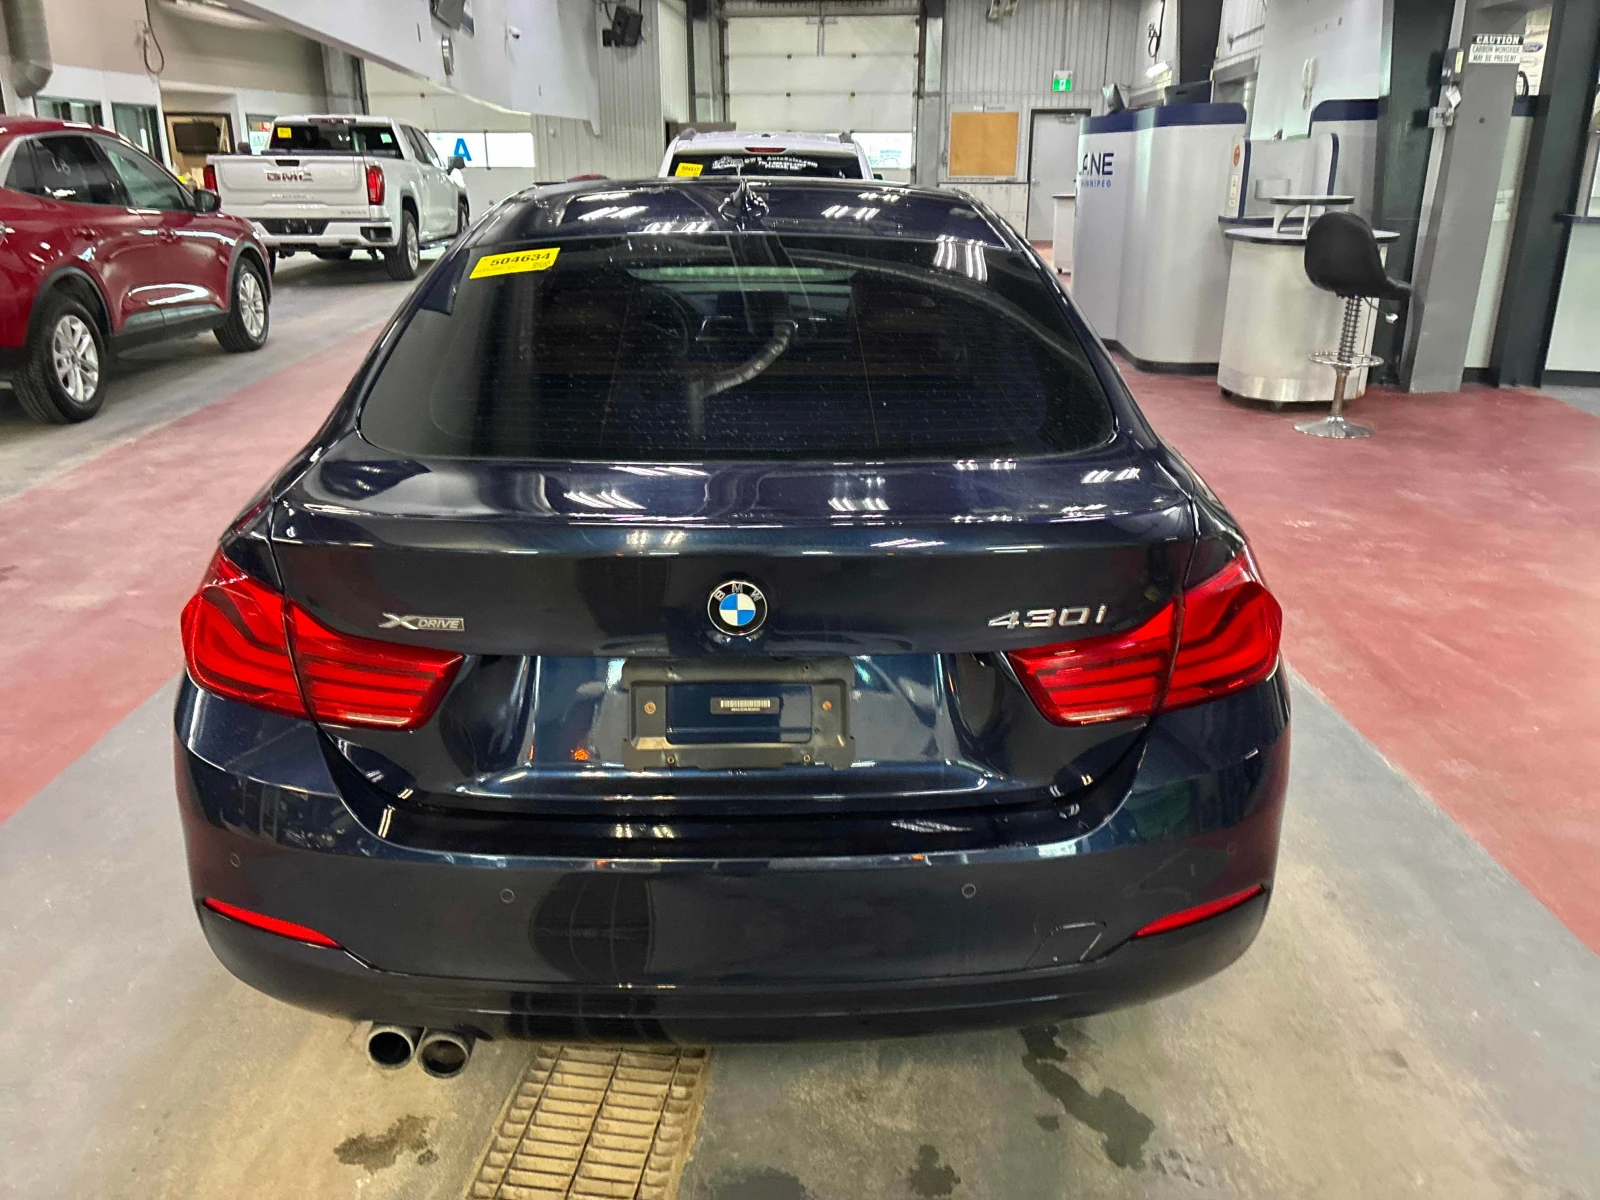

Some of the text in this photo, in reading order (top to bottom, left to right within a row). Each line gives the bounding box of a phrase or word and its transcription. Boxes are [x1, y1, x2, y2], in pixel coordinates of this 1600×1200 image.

[1476, 35, 1519, 45] CAUTION
[1495, 46, 1520, 54] MONOXIDE
[454, 138, 473, 162] A
[266, 172, 314, 183] GMC
[489, 252, 551, 266] 504634
[713, 583, 762, 602] BMW
[988, 604, 1108, 629] 430i
